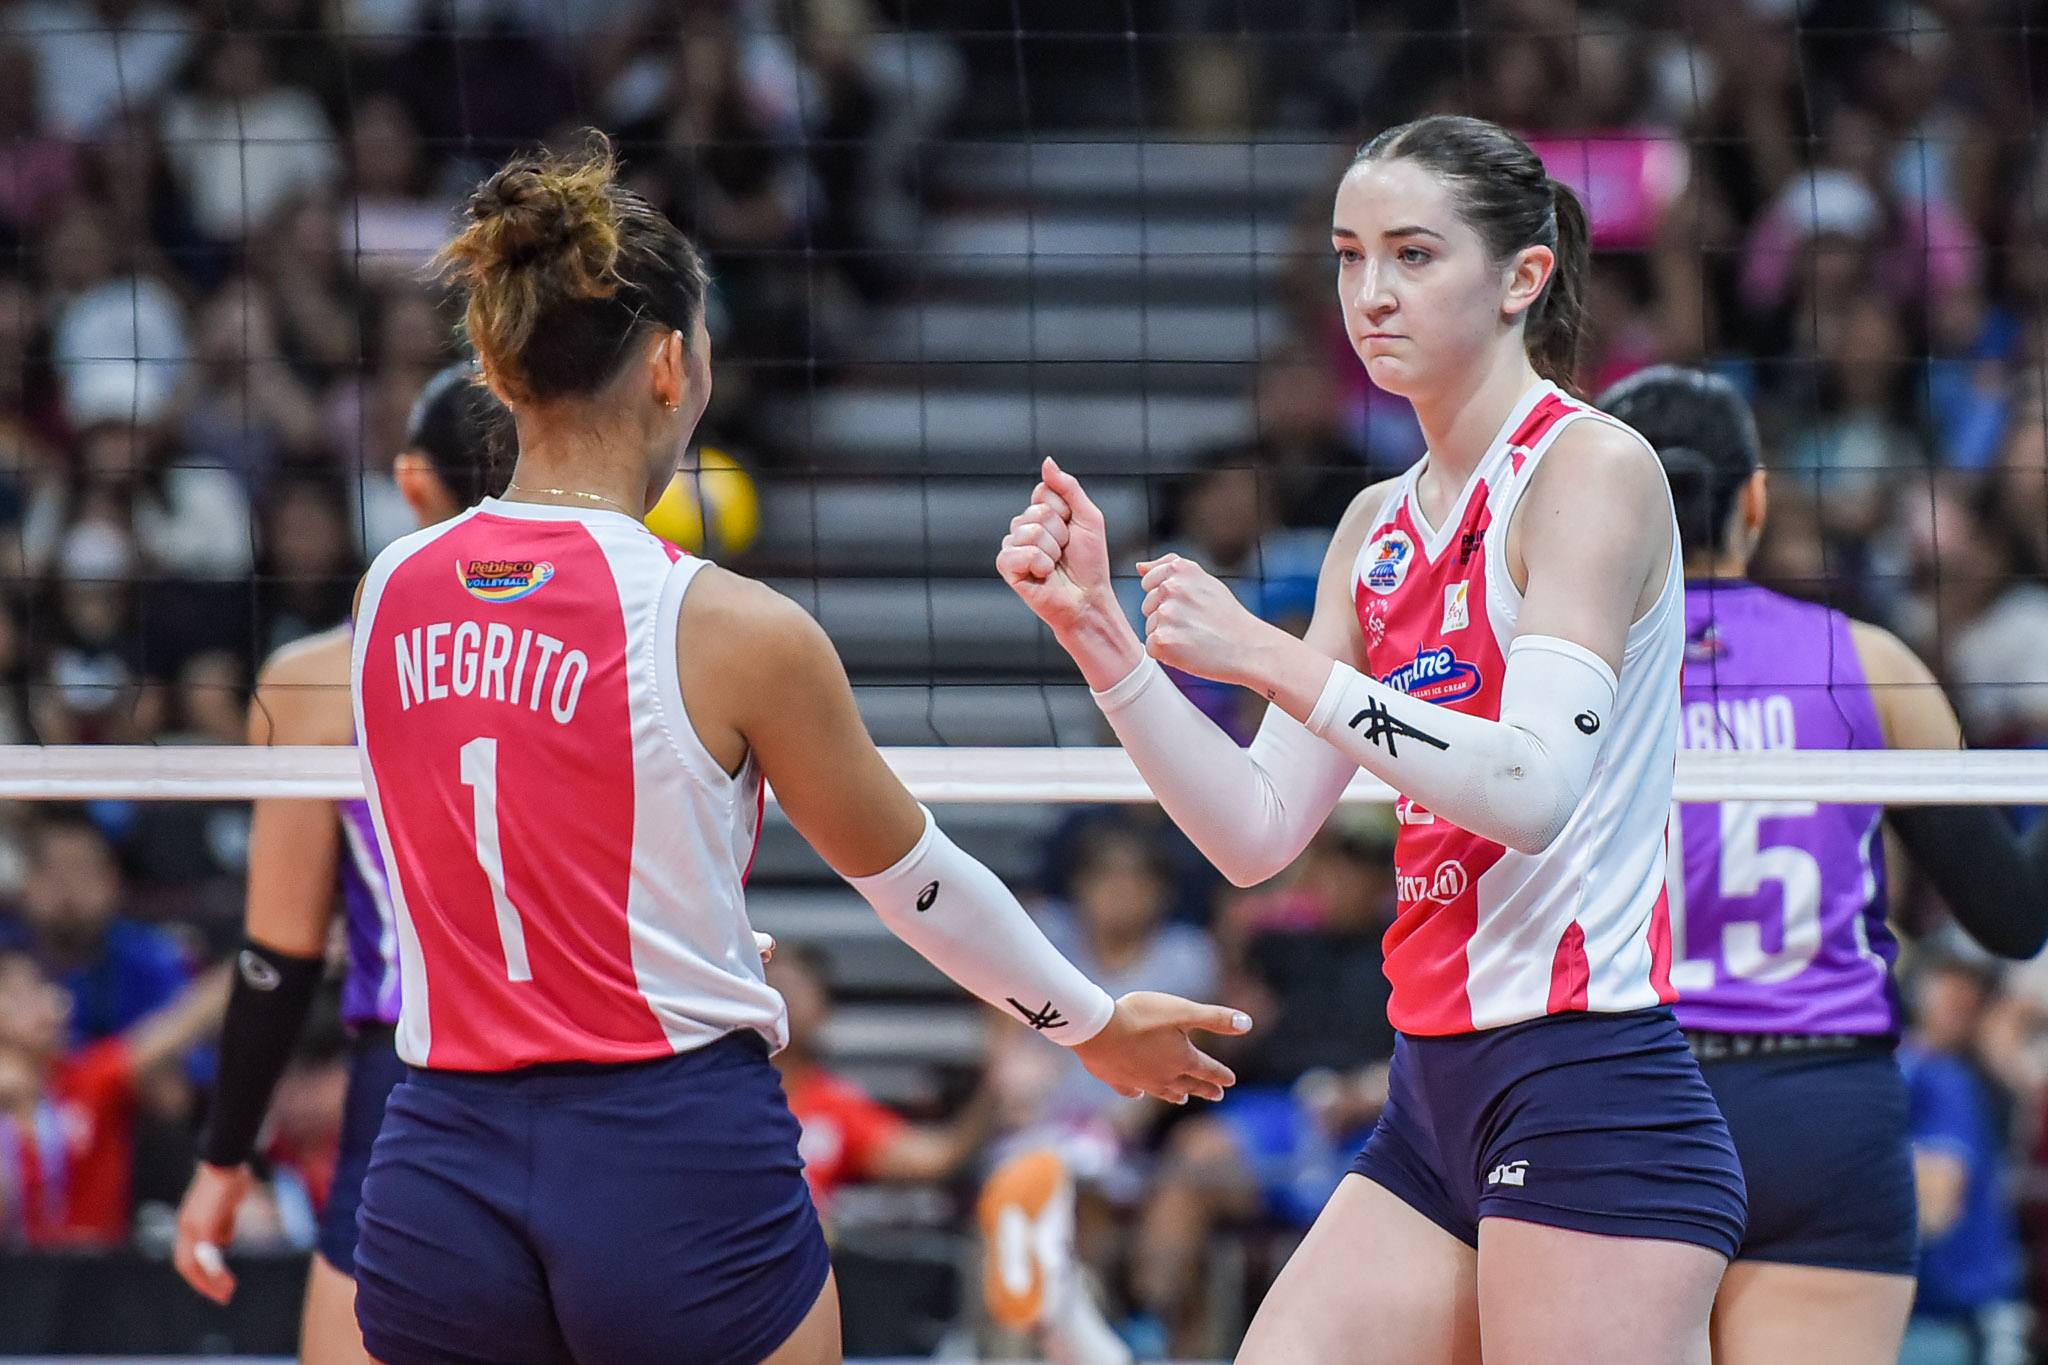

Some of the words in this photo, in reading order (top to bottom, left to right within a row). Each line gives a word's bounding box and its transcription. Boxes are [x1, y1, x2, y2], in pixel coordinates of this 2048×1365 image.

[467, 578, 528, 587] VOLLEYBALL
[394, 620, 589, 724] NEGRITO
[1444, 682, 1467, 693] CREAM
[459, 737, 533, 982] 1
